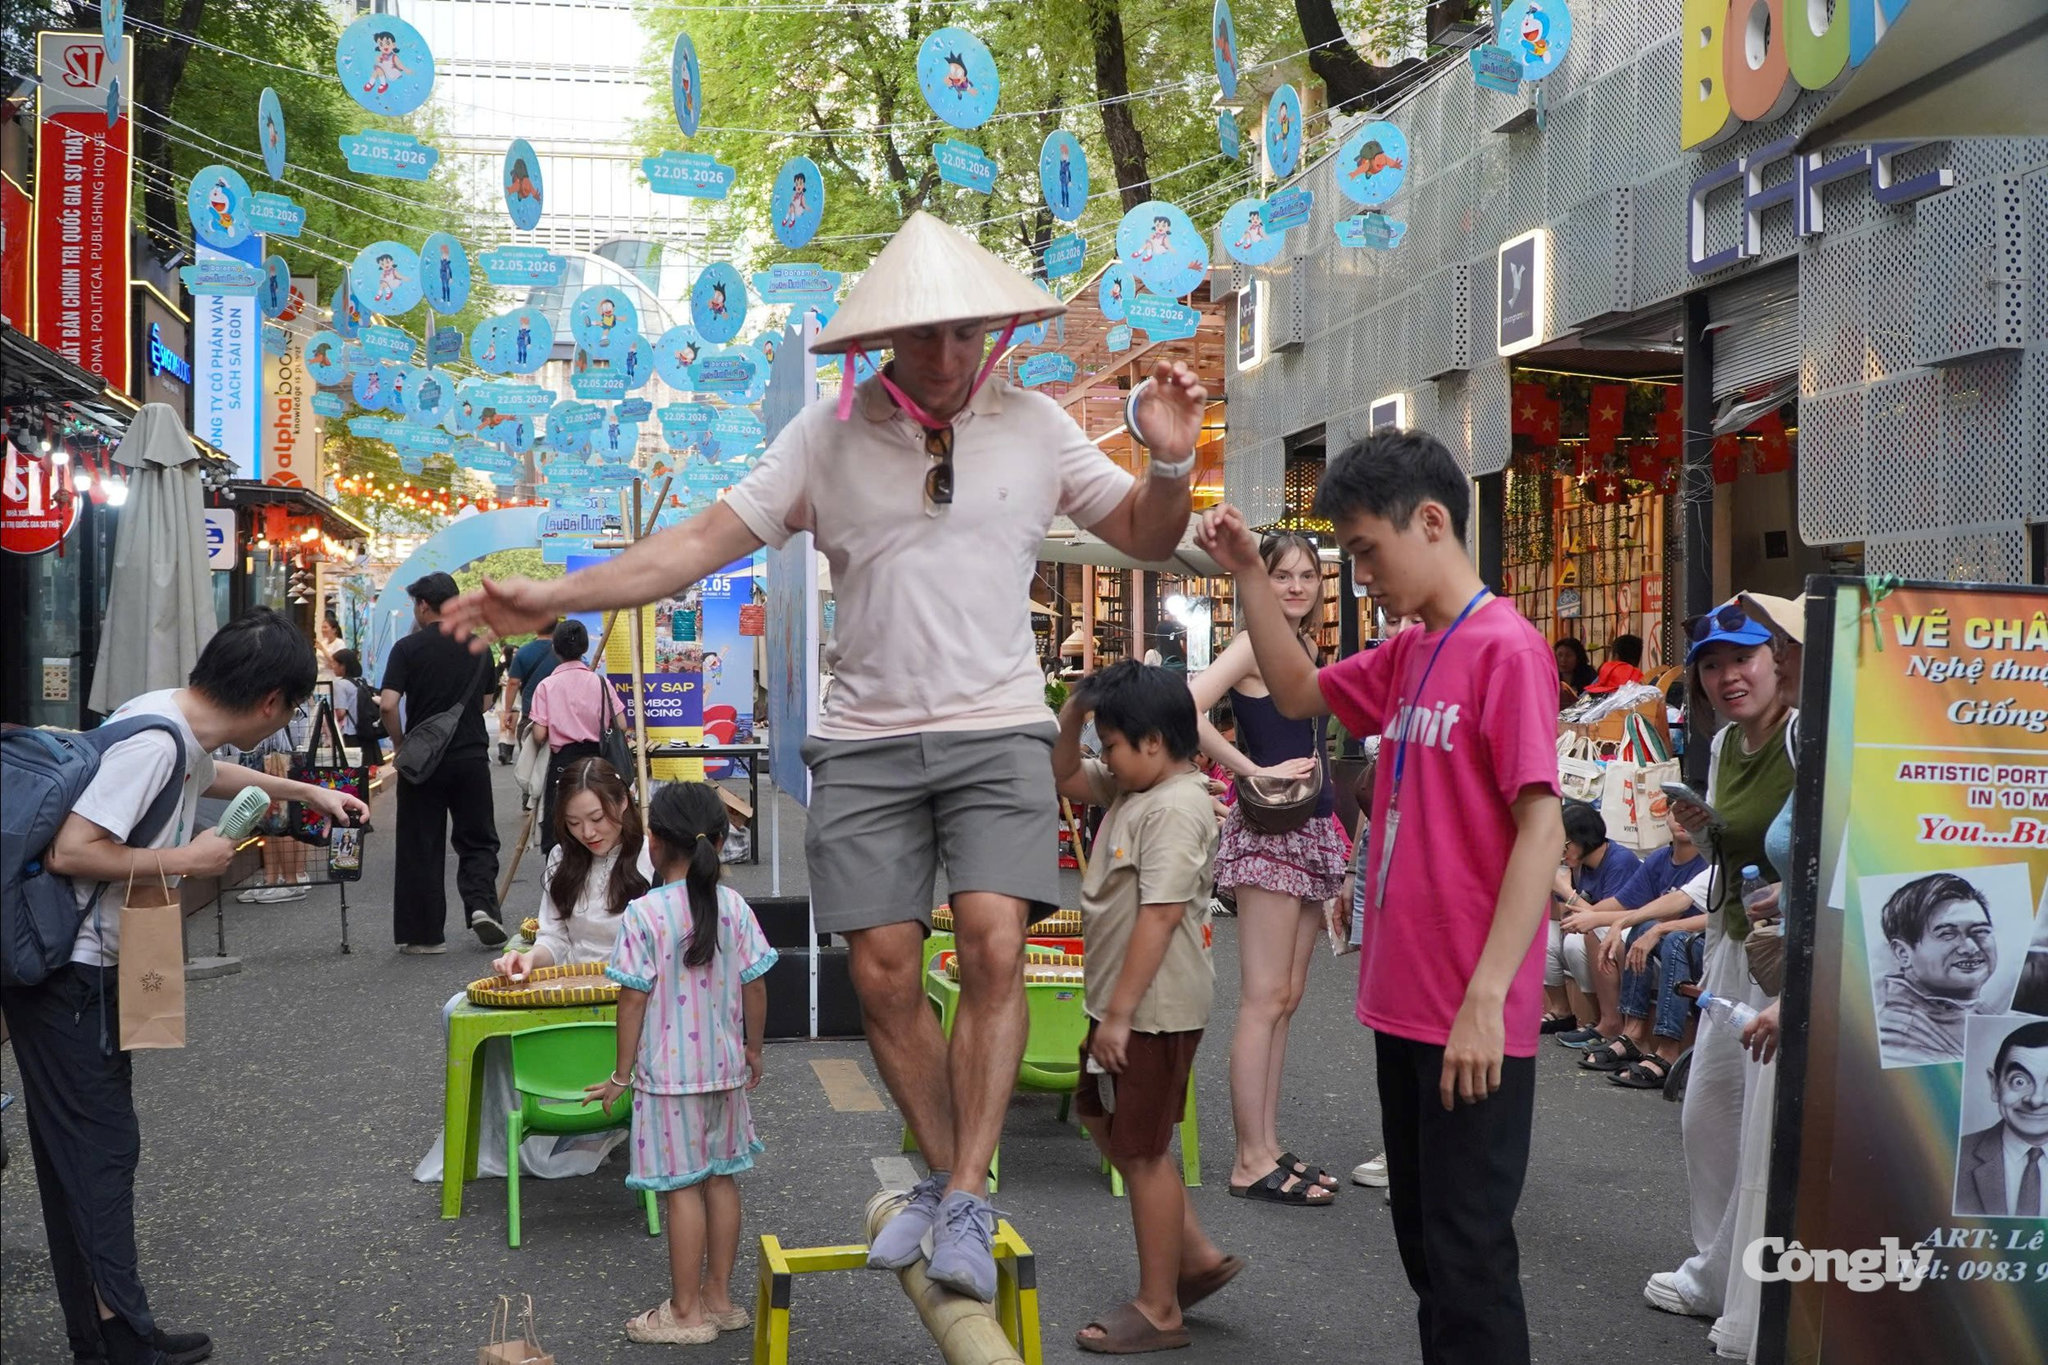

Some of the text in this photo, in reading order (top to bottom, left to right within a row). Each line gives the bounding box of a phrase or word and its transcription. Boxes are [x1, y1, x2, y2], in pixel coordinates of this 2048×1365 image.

[61, 130, 86, 160] THẬT
[93, 132, 107, 177] HOUSE
[351, 142, 426, 165] 22.05.2026
[63, 165, 87, 181] SỰ
[653, 164, 724, 184] 22.05.2026
[942, 151, 990, 178] 22.05.2026
[63, 185, 81, 205] GIA
[91, 182, 105, 260] PUBLISHING
[250, 204, 298, 223] 22.05.2026
[56, 210, 82, 242] QUỐC
[62, 246, 83, 265] TRỊ
[1048, 245, 1081, 265] 22.05.2026
[490, 259, 556, 273] 22.05.2026
[58, 269, 80, 307] CHÍNH
[90, 264, 103, 332] POLITICAL
[1130, 304, 1184, 320] 22.05.2026
[56, 311, 80, 337] BẢN
[225, 308, 241, 338] GÒN
[365, 333, 409, 352] 22.05.2026
[226, 370, 241, 409] SÁCH
[578, 379, 624, 389] 22.05.2026
[211, 395, 223, 412] TY
[497, 394, 549, 404] 22.05.2026
[293, 386, 302, 435] knowledge
[565, 411, 601, 424] 22.05.2026
[664, 412, 708, 422] 22.05.2026
[716, 423, 762, 435] 22.05.2026
[410, 434, 449, 446] 22.05.2026
[474, 456, 512, 467] 22.05.2026
[688, 472, 729, 481] 22.05.2026
[1892, 608, 1949, 649] VẼ
[1906, 654, 1985, 683] Nghệ
[615, 682, 695, 694] NHY SẠP
[627, 698, 682, 707] BMBOO
[627, 708, 683, 717] DNCING
[1947, 697, 2048, 733] Giống
[1899, 763, 1990, 782] ARTISTIC
[1970, 789, 1993, 806] IN
[2001, 790, 2026, 807] 10
[1921, 1227, 2045, 1251] ART: Lê
[1957, 1260, 2028, 1282] 0983
